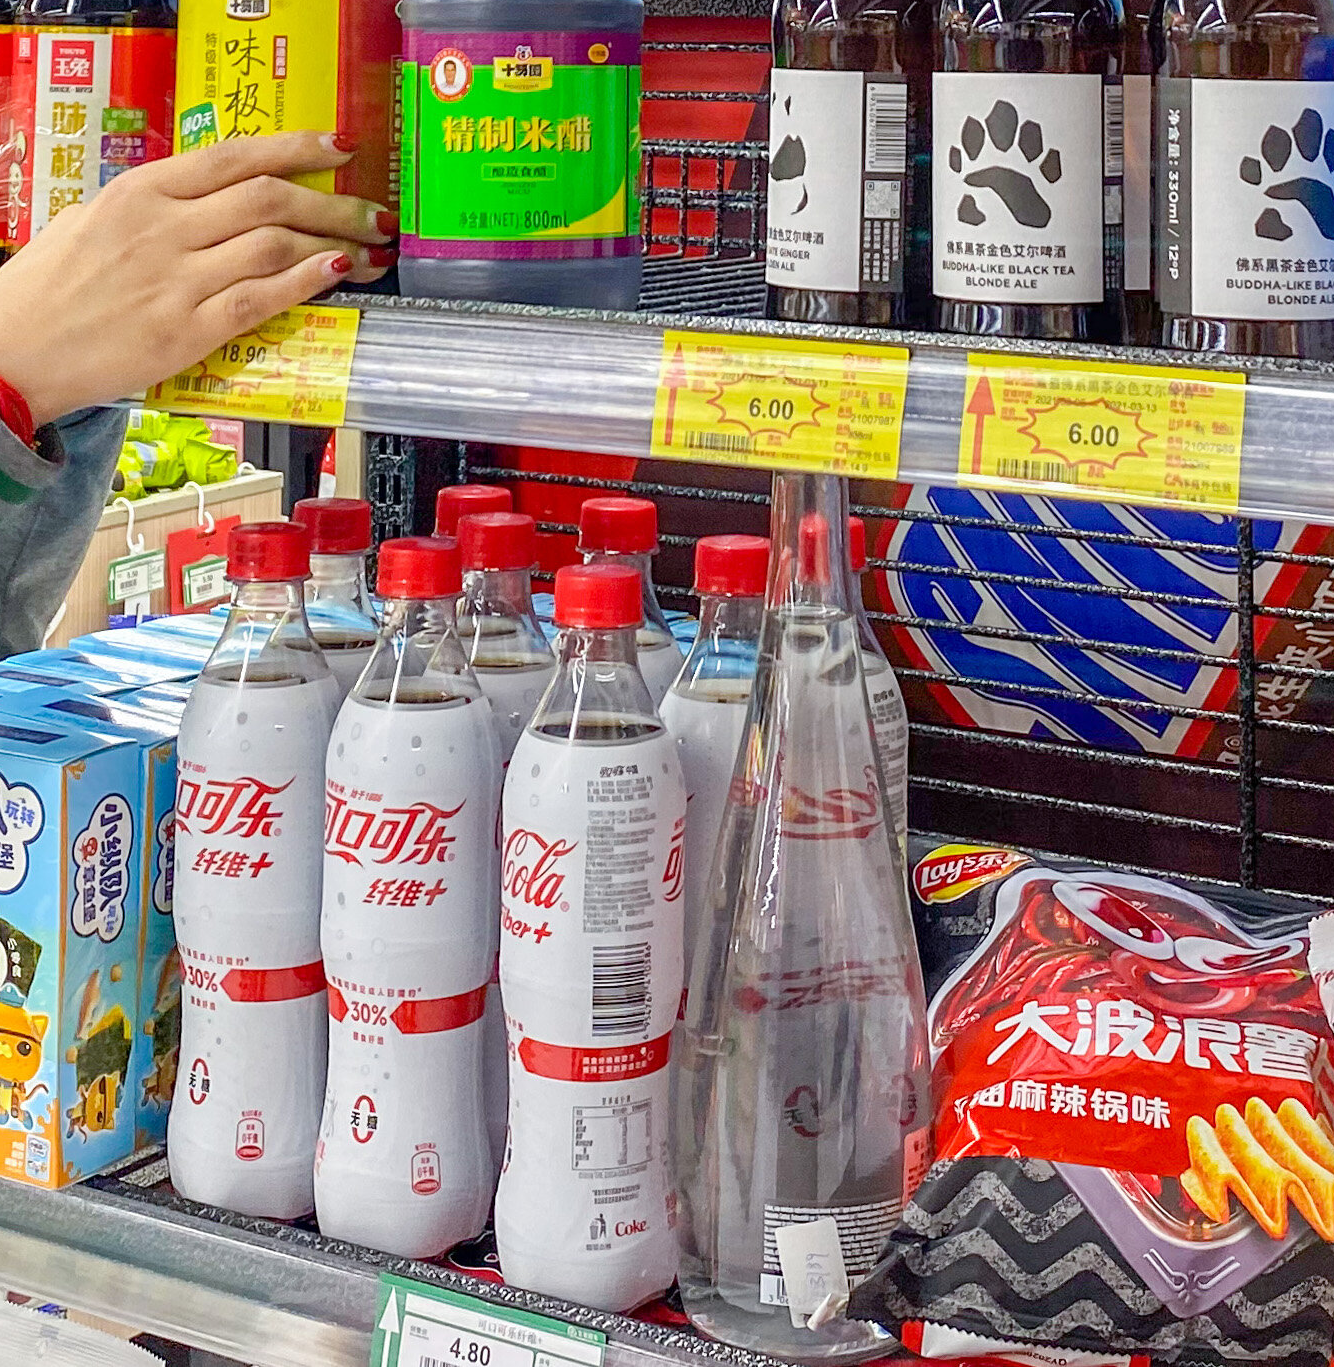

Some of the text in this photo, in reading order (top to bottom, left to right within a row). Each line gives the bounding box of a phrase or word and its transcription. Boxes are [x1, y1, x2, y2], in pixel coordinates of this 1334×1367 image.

[224, 28, 270, 138] 味极
[441, 115, 593, 153] 精制米醋
[946, 242, 1067, 259] 佛系黑茶金色艾尔啤酒
[942, 260, 1075, 276] BUDDHA-LIKE BLACK TEA
[965, 277, 1038, 289] BLONDE ALE
[1226, 278, 1312, 291] BUDDHA-LIKE
[1267, 294, 1317, 305] BLONDE
[219, 342, 268, 364] 18.90
[748, 397, 795, 421] 6.00
[1068, 422, 1120, 447] 6.00
[175, 773, 297, 839] 口可乐
[502, 828, 580, 910] Cola
[920, 855, 976, 890] Lay's
[501, 902, 553, 945] iber+
[187, 965, 219, 994] 30%
[350, 1000, 388, 1027] 30%
[614, 1217, 647, 1238] Coke
[449, 1337, 492, 1367] 4.80
